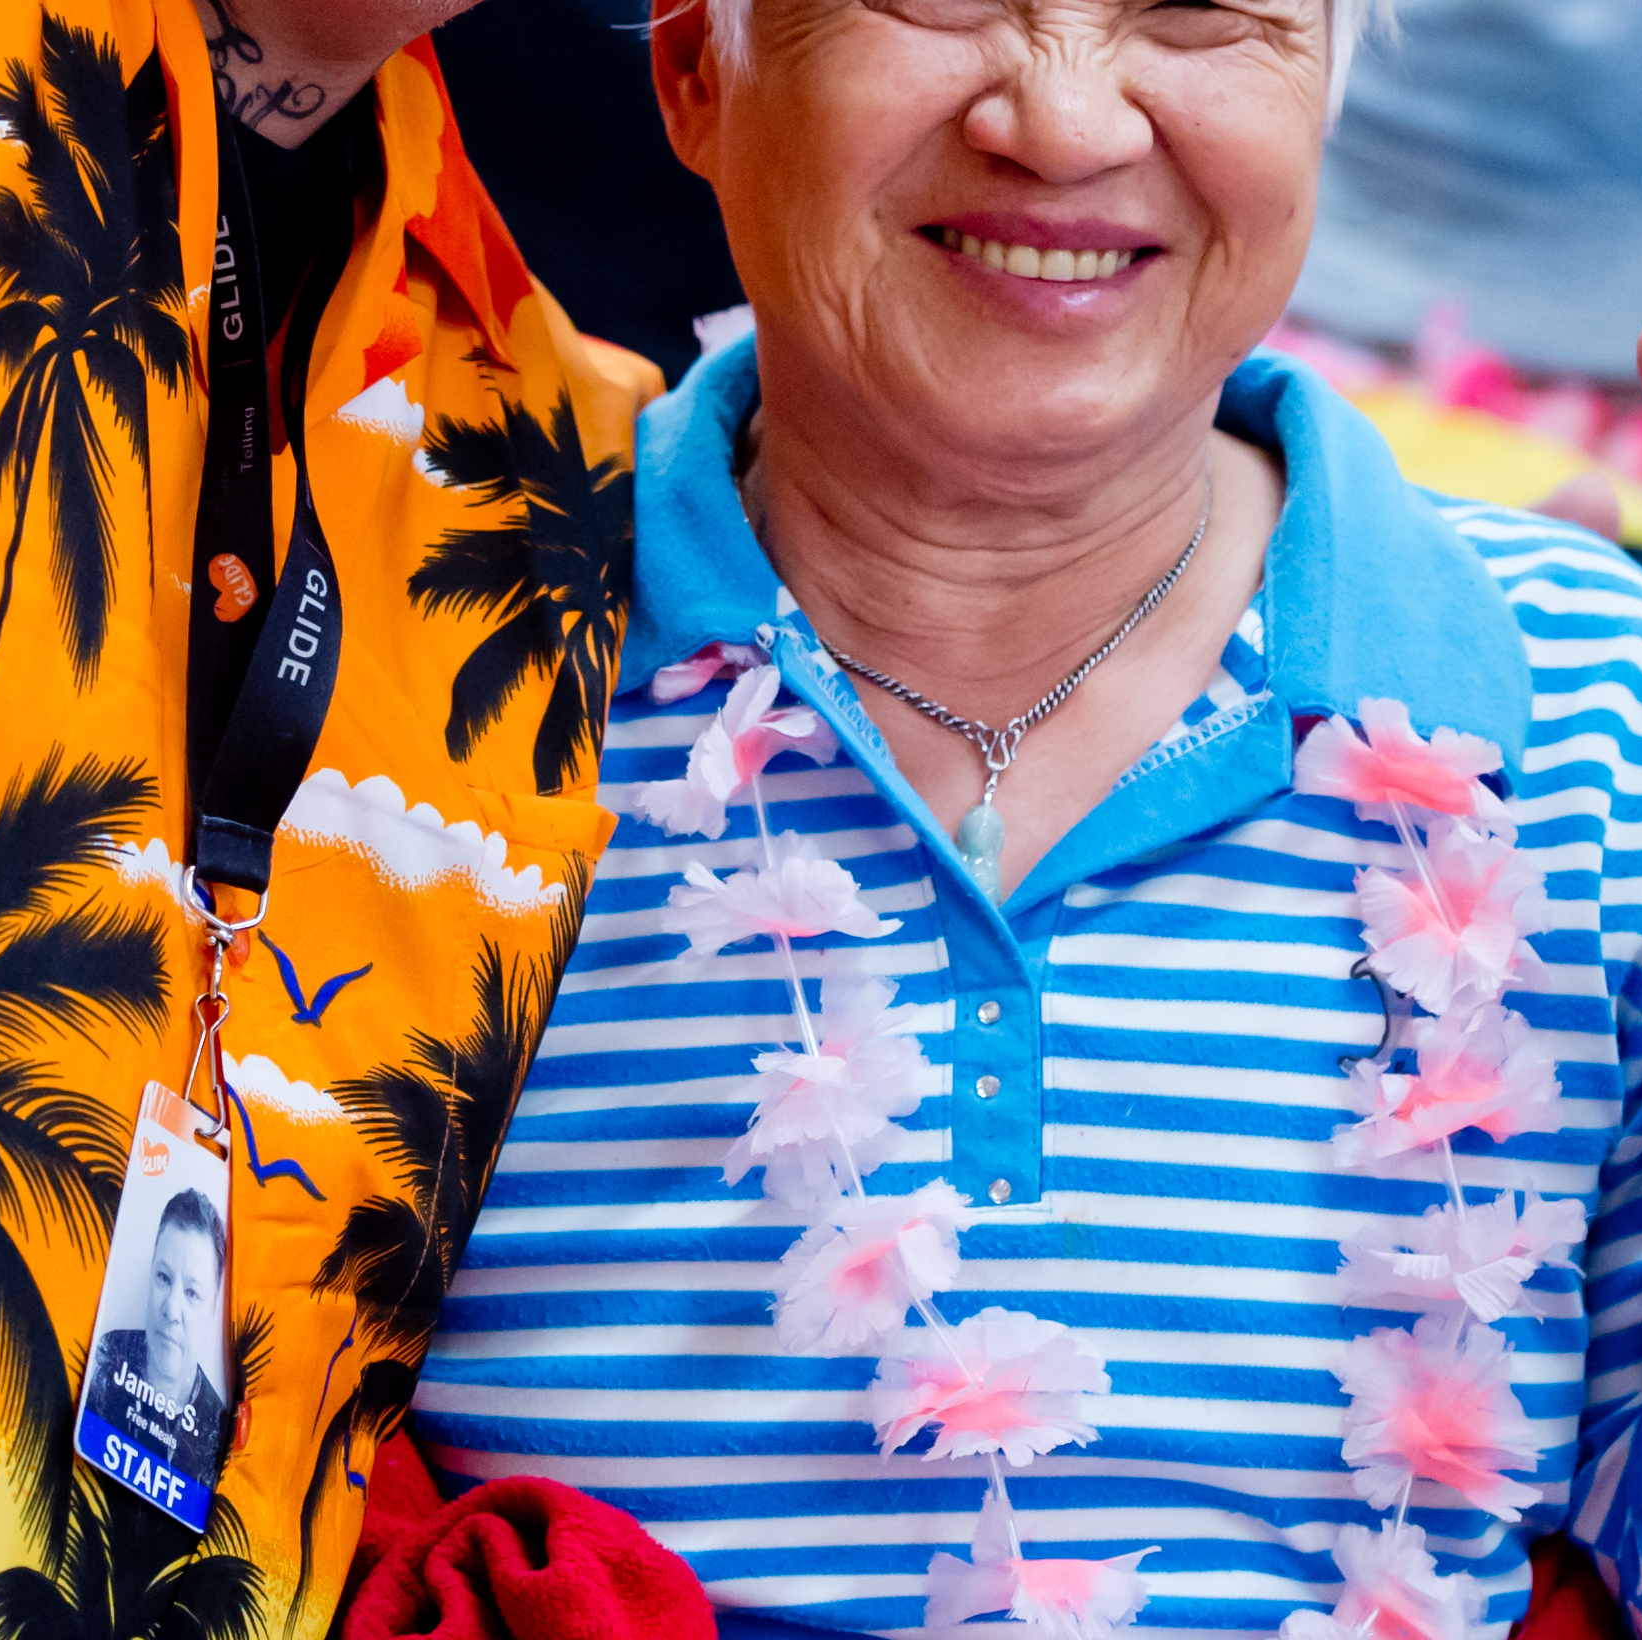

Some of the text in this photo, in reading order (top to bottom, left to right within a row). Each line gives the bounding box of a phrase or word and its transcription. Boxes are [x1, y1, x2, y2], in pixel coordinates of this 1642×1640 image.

[240, 406, 255, 474] Telling
[276, 568, 329, 687] GLIDE
[141, 1153, 169, 1173] GLIDE
[113, 1361, 199, 1437] James S.
[126, 1405, 177, 1450] Free Meals
[103, 1433, 186, 1508] STAFF
